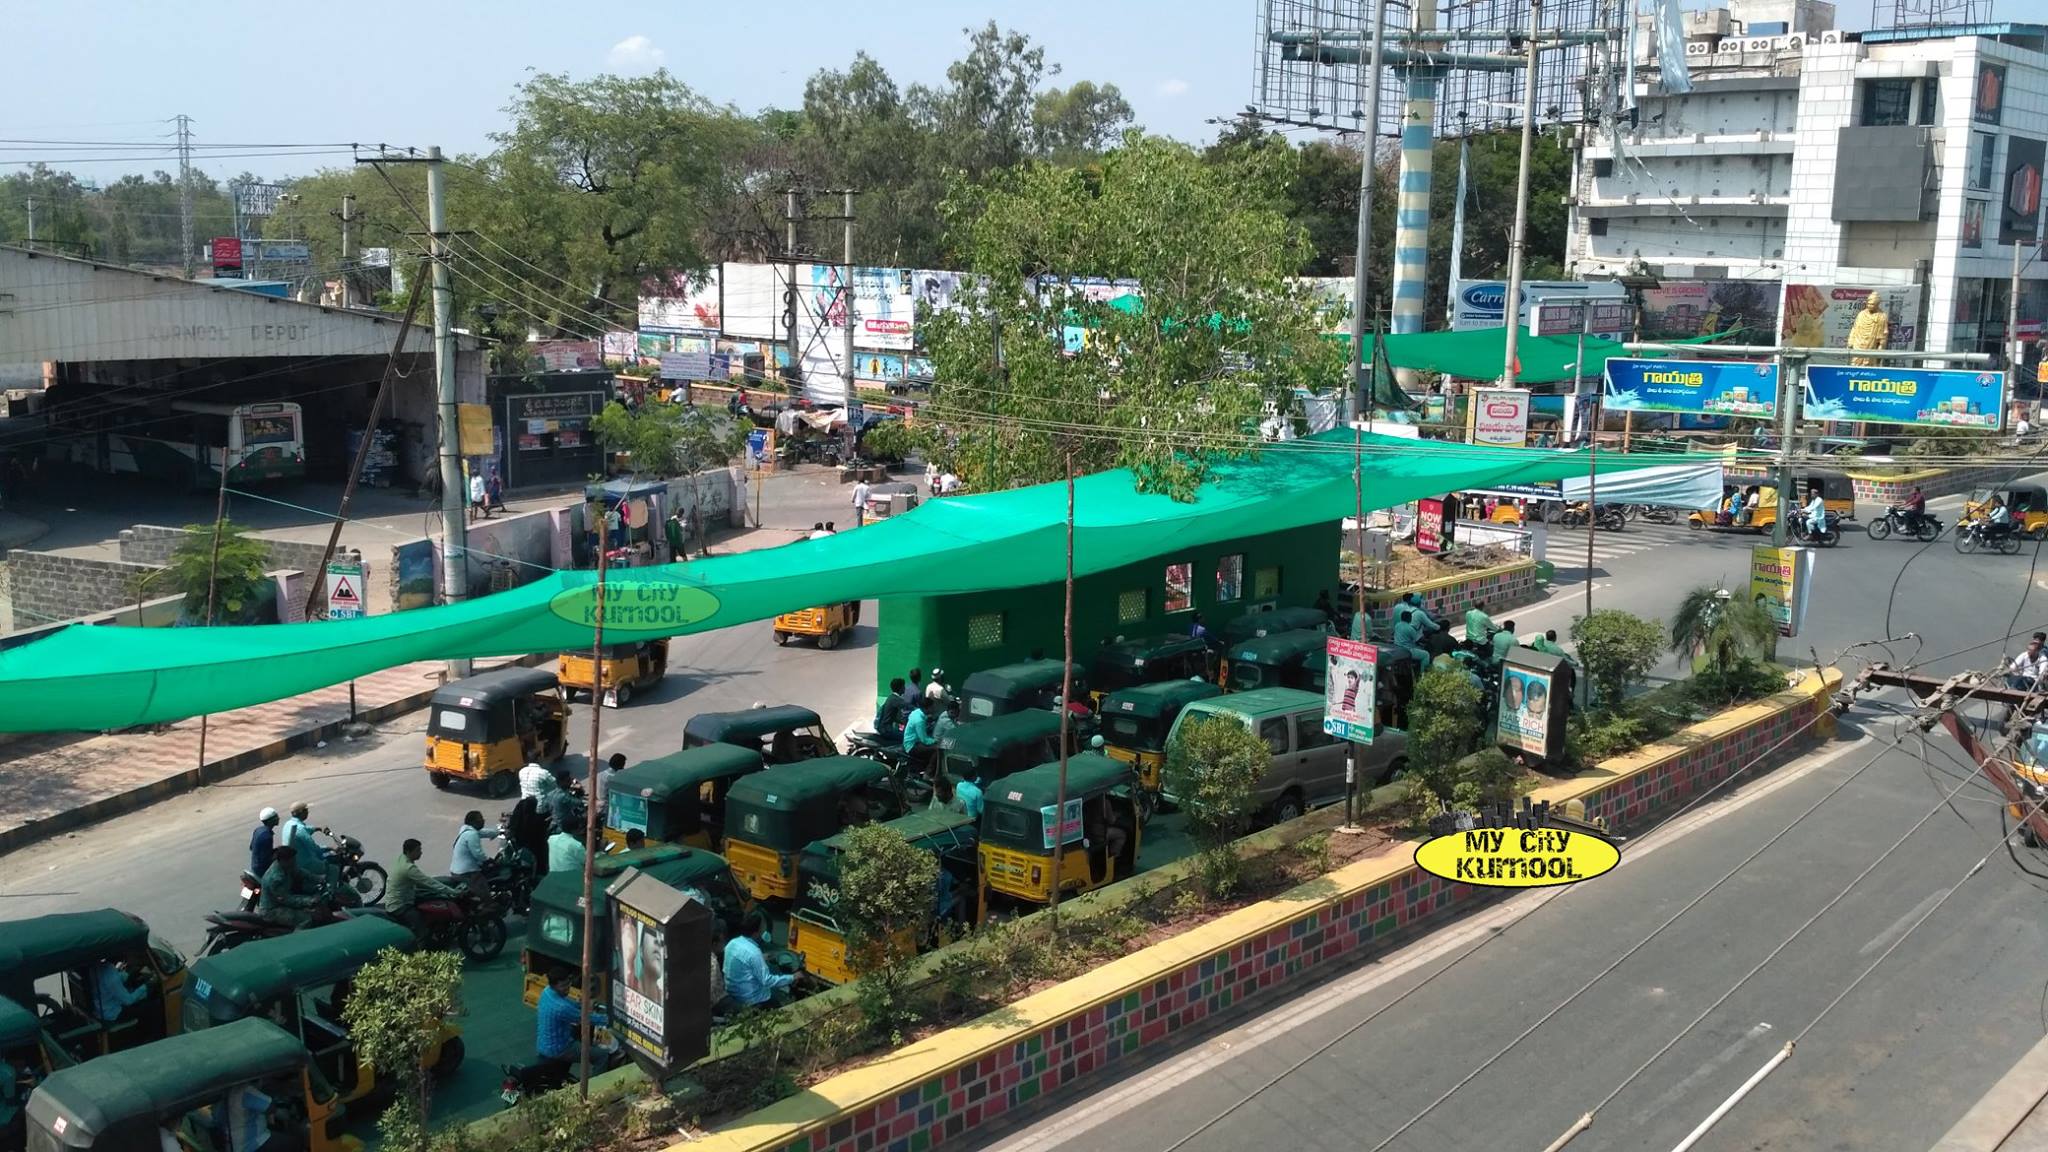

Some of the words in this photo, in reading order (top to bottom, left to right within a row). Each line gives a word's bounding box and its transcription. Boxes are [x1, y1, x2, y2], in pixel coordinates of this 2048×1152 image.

[1471, 290, 1507, 304] Carri
[251, 324, 309, 341] DEPOT
[1643, 371, 1704, 387] గాయత్రి
[1849, 378, 1918, 396] గాయత్రి
[1420, 511, 1441, 523] NOW
[1331, 719, 1345, 736] SBI
[1523, 717, 1544, 732] RICH
[643, 998, 662, 1023] SKIN
